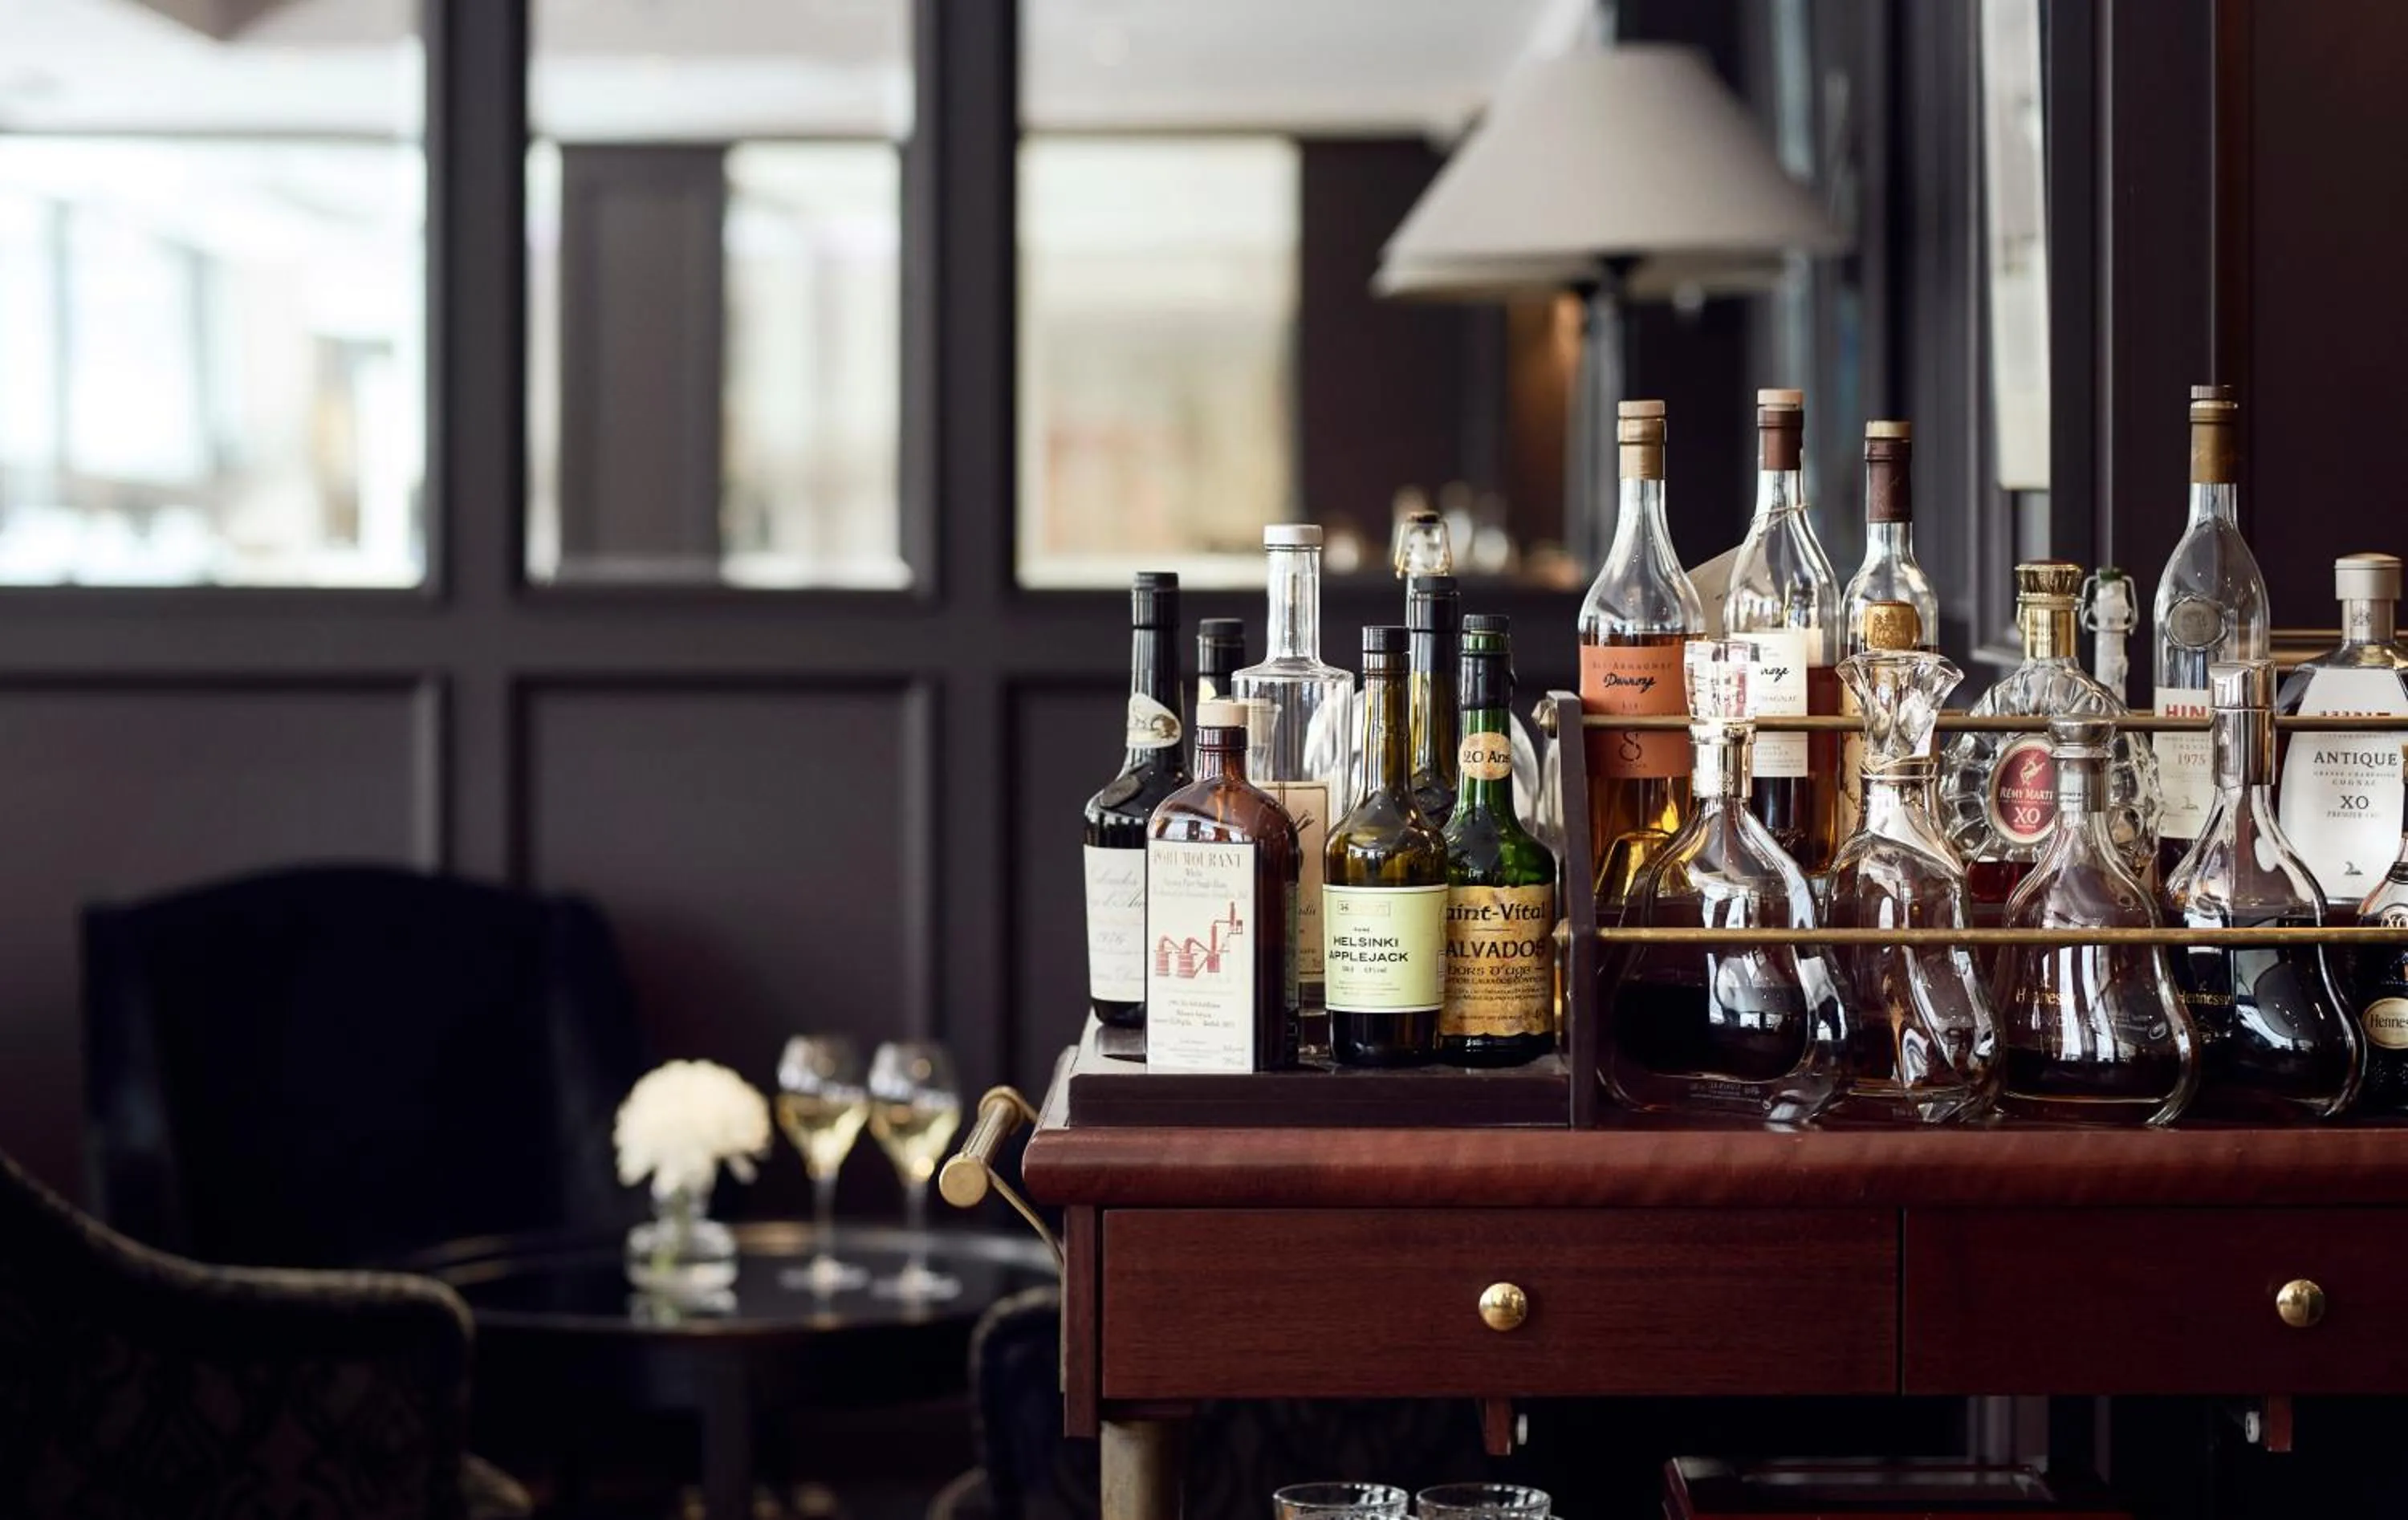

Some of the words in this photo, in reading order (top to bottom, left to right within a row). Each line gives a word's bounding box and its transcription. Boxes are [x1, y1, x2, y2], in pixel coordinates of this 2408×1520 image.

[2165, 704, 2207, 717] HIN
[1463, 750, 1484, 763] 20
[1487, 750, 1511, 763] Ans
[2178, 753, 2207, 765] 1975
[2313, 750, 2398, 768] ANTIQUE
[2332, 778, 2377, 786] COGNAC
[2024, 787, 2055, 801] MARTI
[2341, 795, 2369, 809] XO
[2013, 806, 2040, 824] XO
[1154, 849, 1178, 866] PORT
[1184, 851, 1242, 868] MOURANT
[1446, 902, 1546, 921] aint-Vital
[1333, 936, 1400, 948] HELSINKI
[1328, 950, 1409, 963] APPLEJACK
[1446, 940, 1546, 959] ALVADOS
